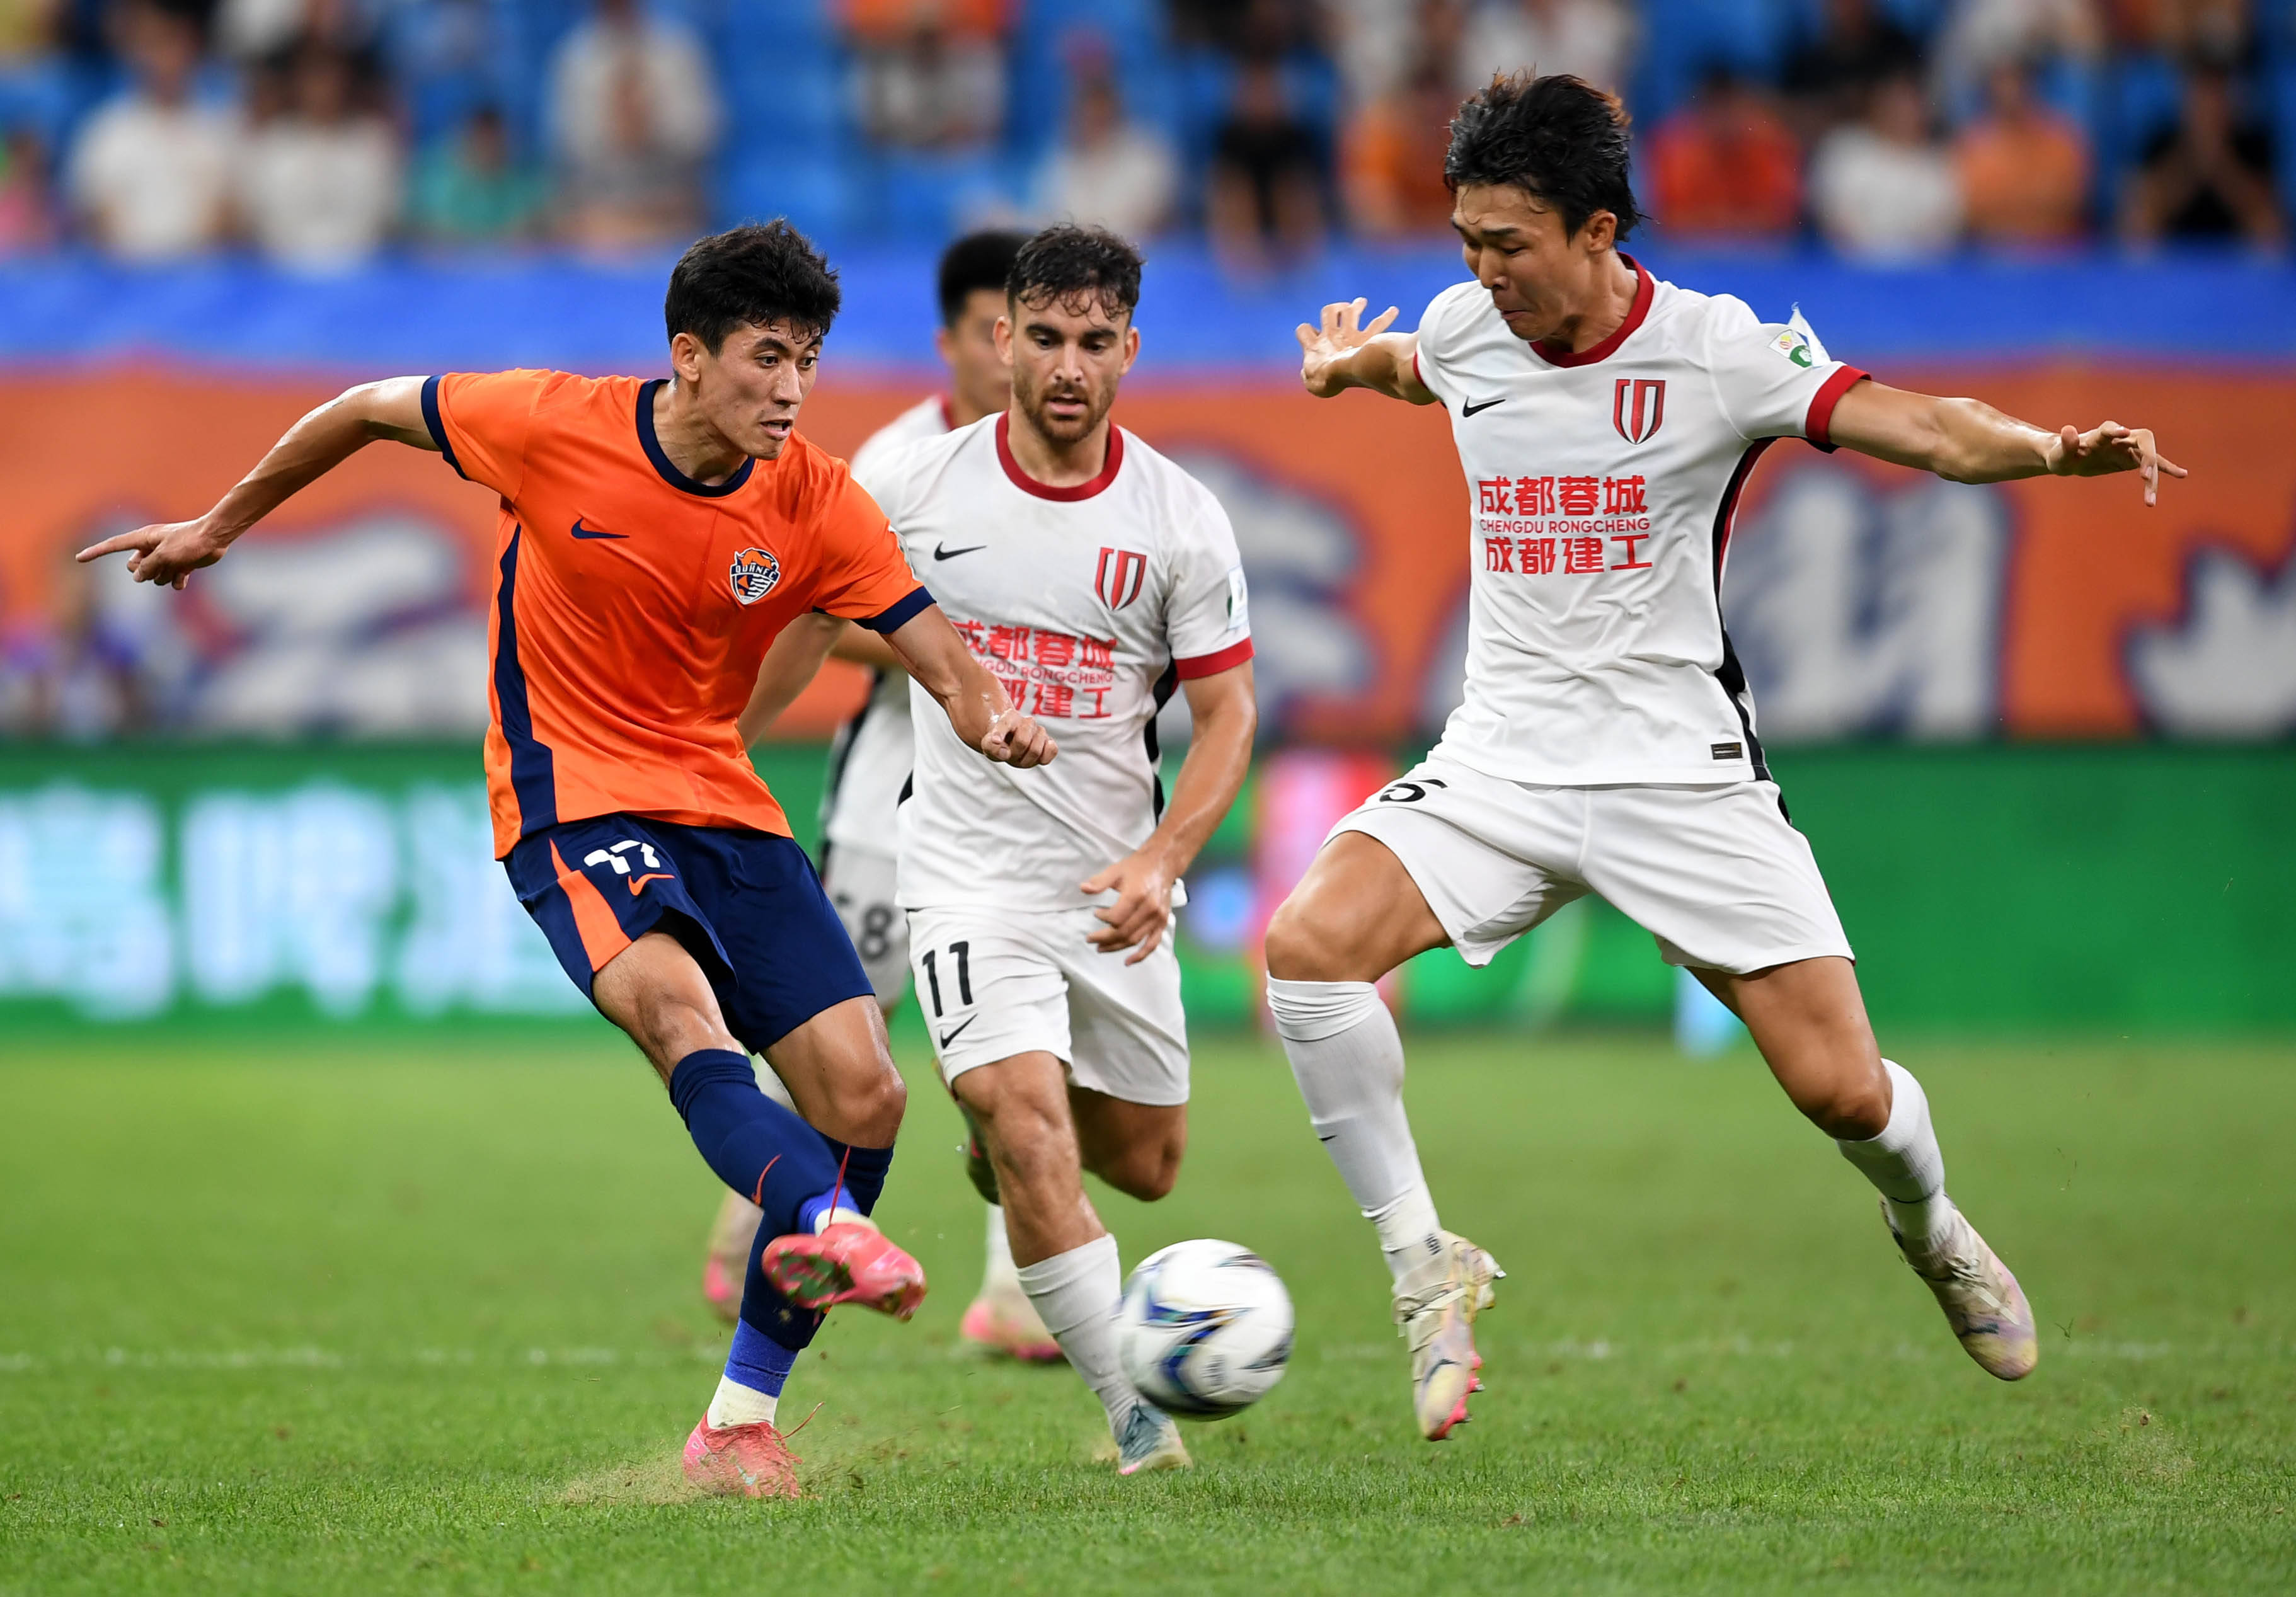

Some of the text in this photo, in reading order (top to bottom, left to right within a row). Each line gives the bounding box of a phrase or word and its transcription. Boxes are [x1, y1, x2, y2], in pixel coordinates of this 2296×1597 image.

[1478, 474, 1649, 516] 成都蓉城
[1480, 518, 1650, 533] CHENGDU RONGCHENG
[1484, 534, 1653, 575] 成都建工
[1021, 665, 1113, 684] RONGCHENG
[922, 941, 973, 1018] 11
